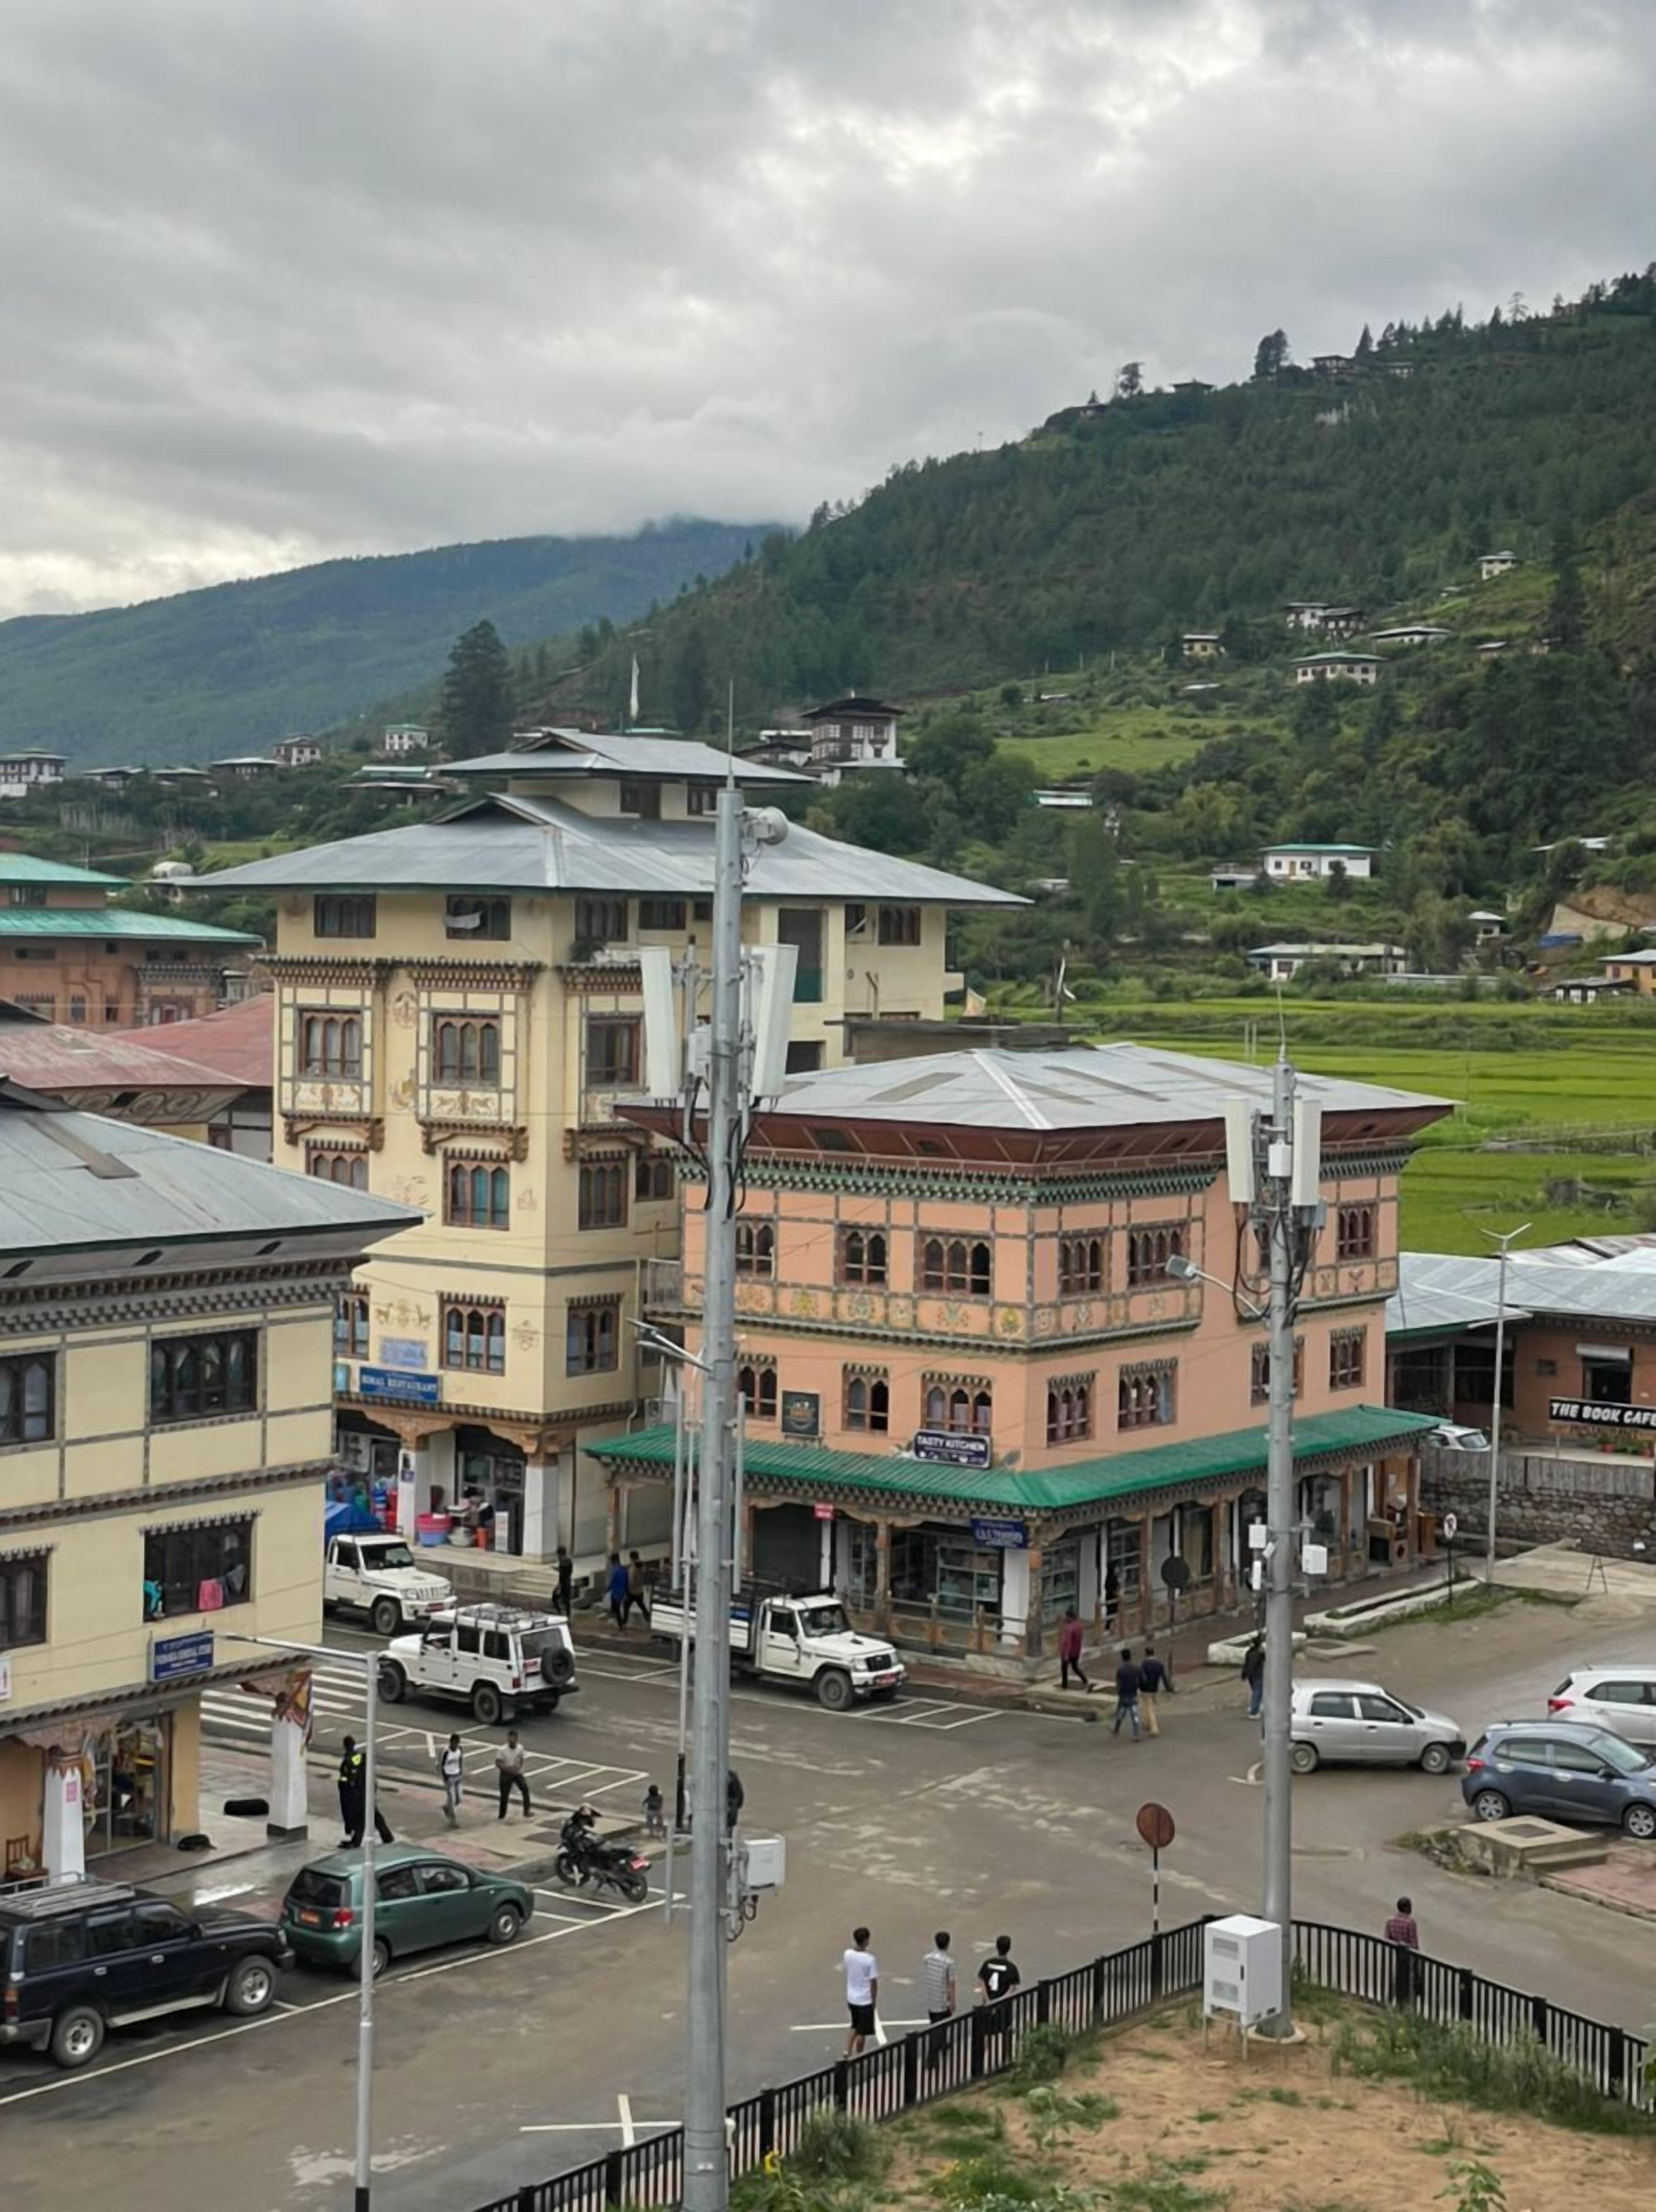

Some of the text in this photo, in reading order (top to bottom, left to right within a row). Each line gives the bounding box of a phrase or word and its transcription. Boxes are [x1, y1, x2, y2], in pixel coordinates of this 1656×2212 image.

[1552, 1402, 1579, 1418] THE
[1582, 1405, 1621, 1422] BOOK
[917, 1435, 943, 1447] TASTY
[945, 1439, 985, 1452] KITCHEN
